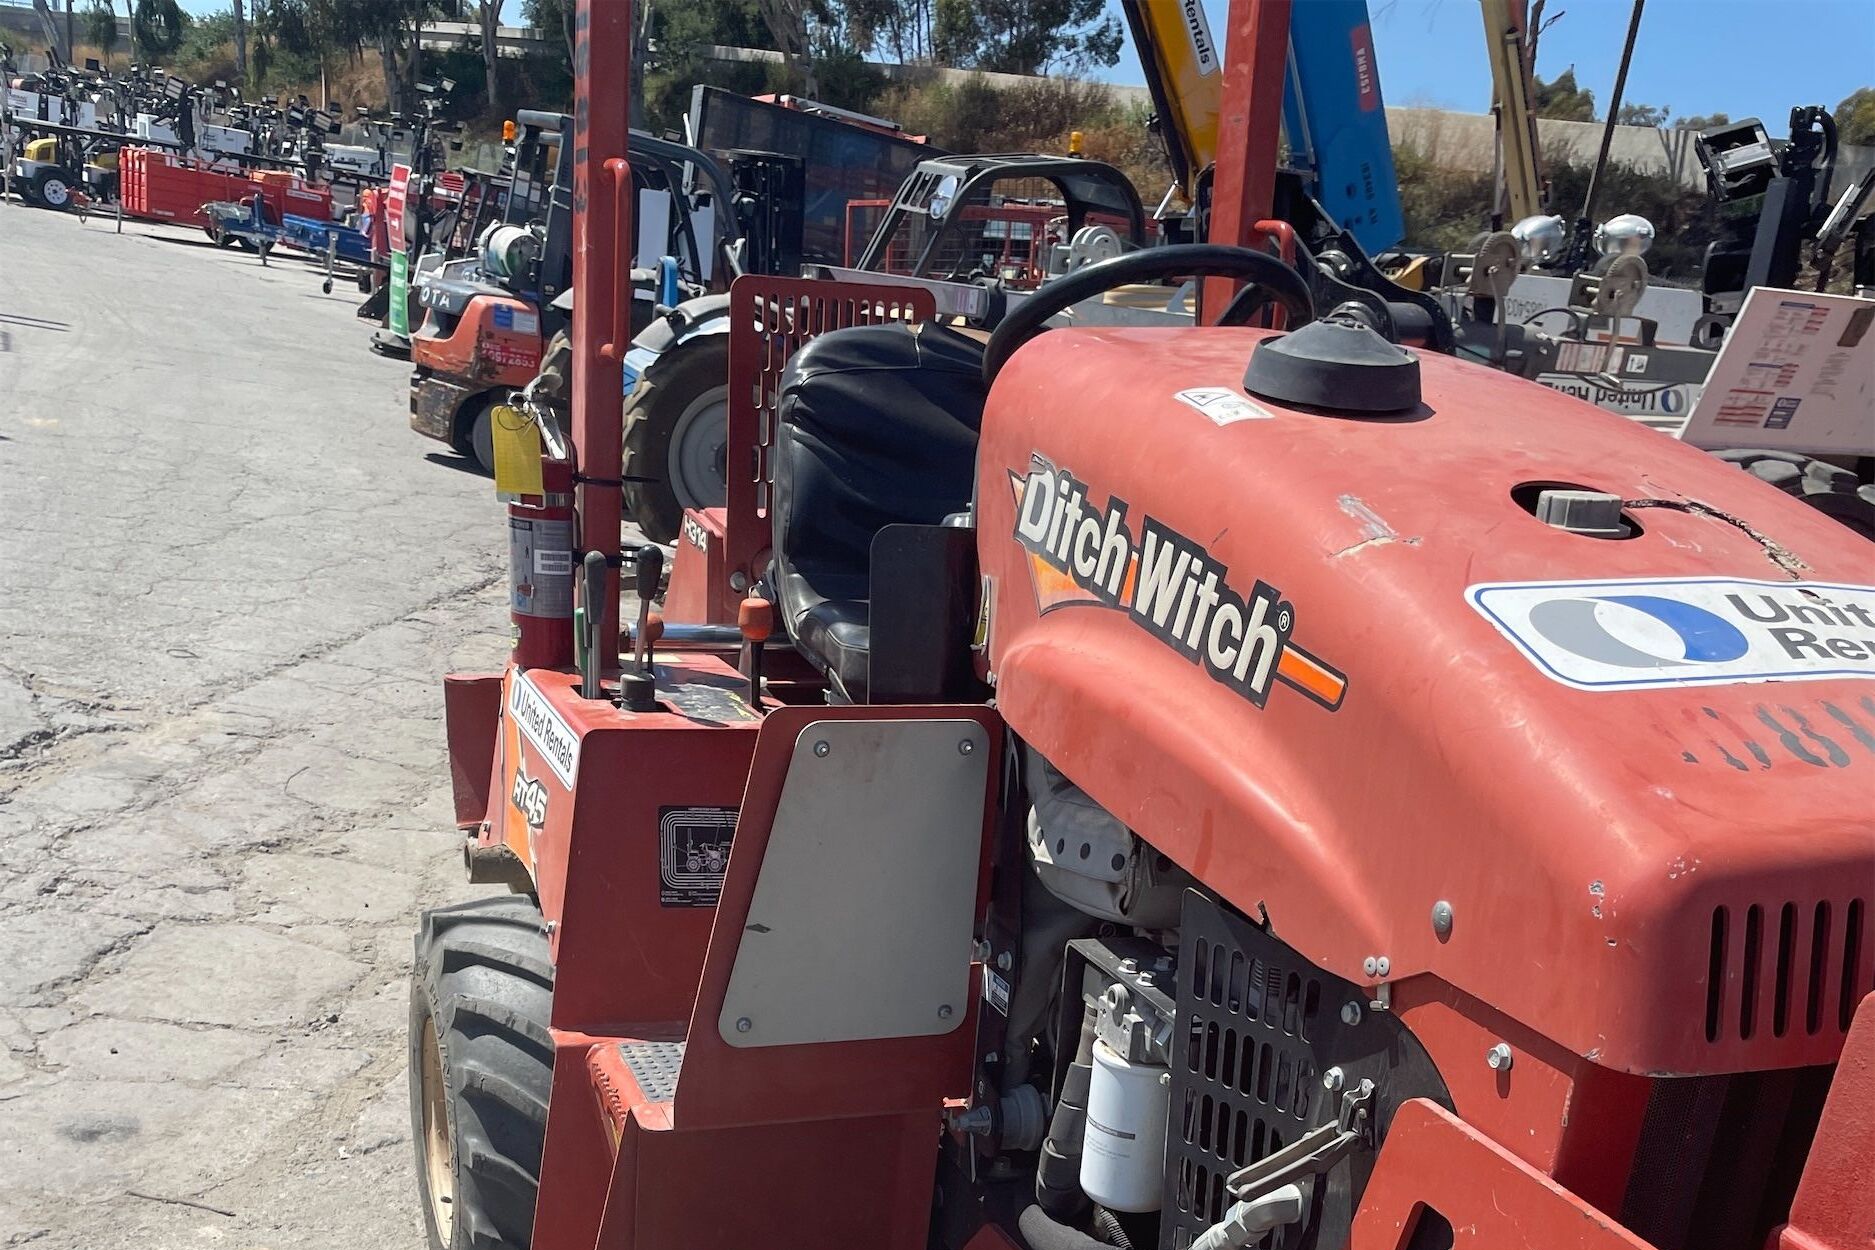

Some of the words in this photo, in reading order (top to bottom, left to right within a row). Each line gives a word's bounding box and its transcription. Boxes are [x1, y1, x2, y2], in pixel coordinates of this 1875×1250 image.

[684, 514, 707, 553] H314
[1018, 470, 1132, 596] Ditch
[521, 689, 547, 738] United
[544, 717, 573, 774] Rentals
[512, 774, 548, 826] RT45
